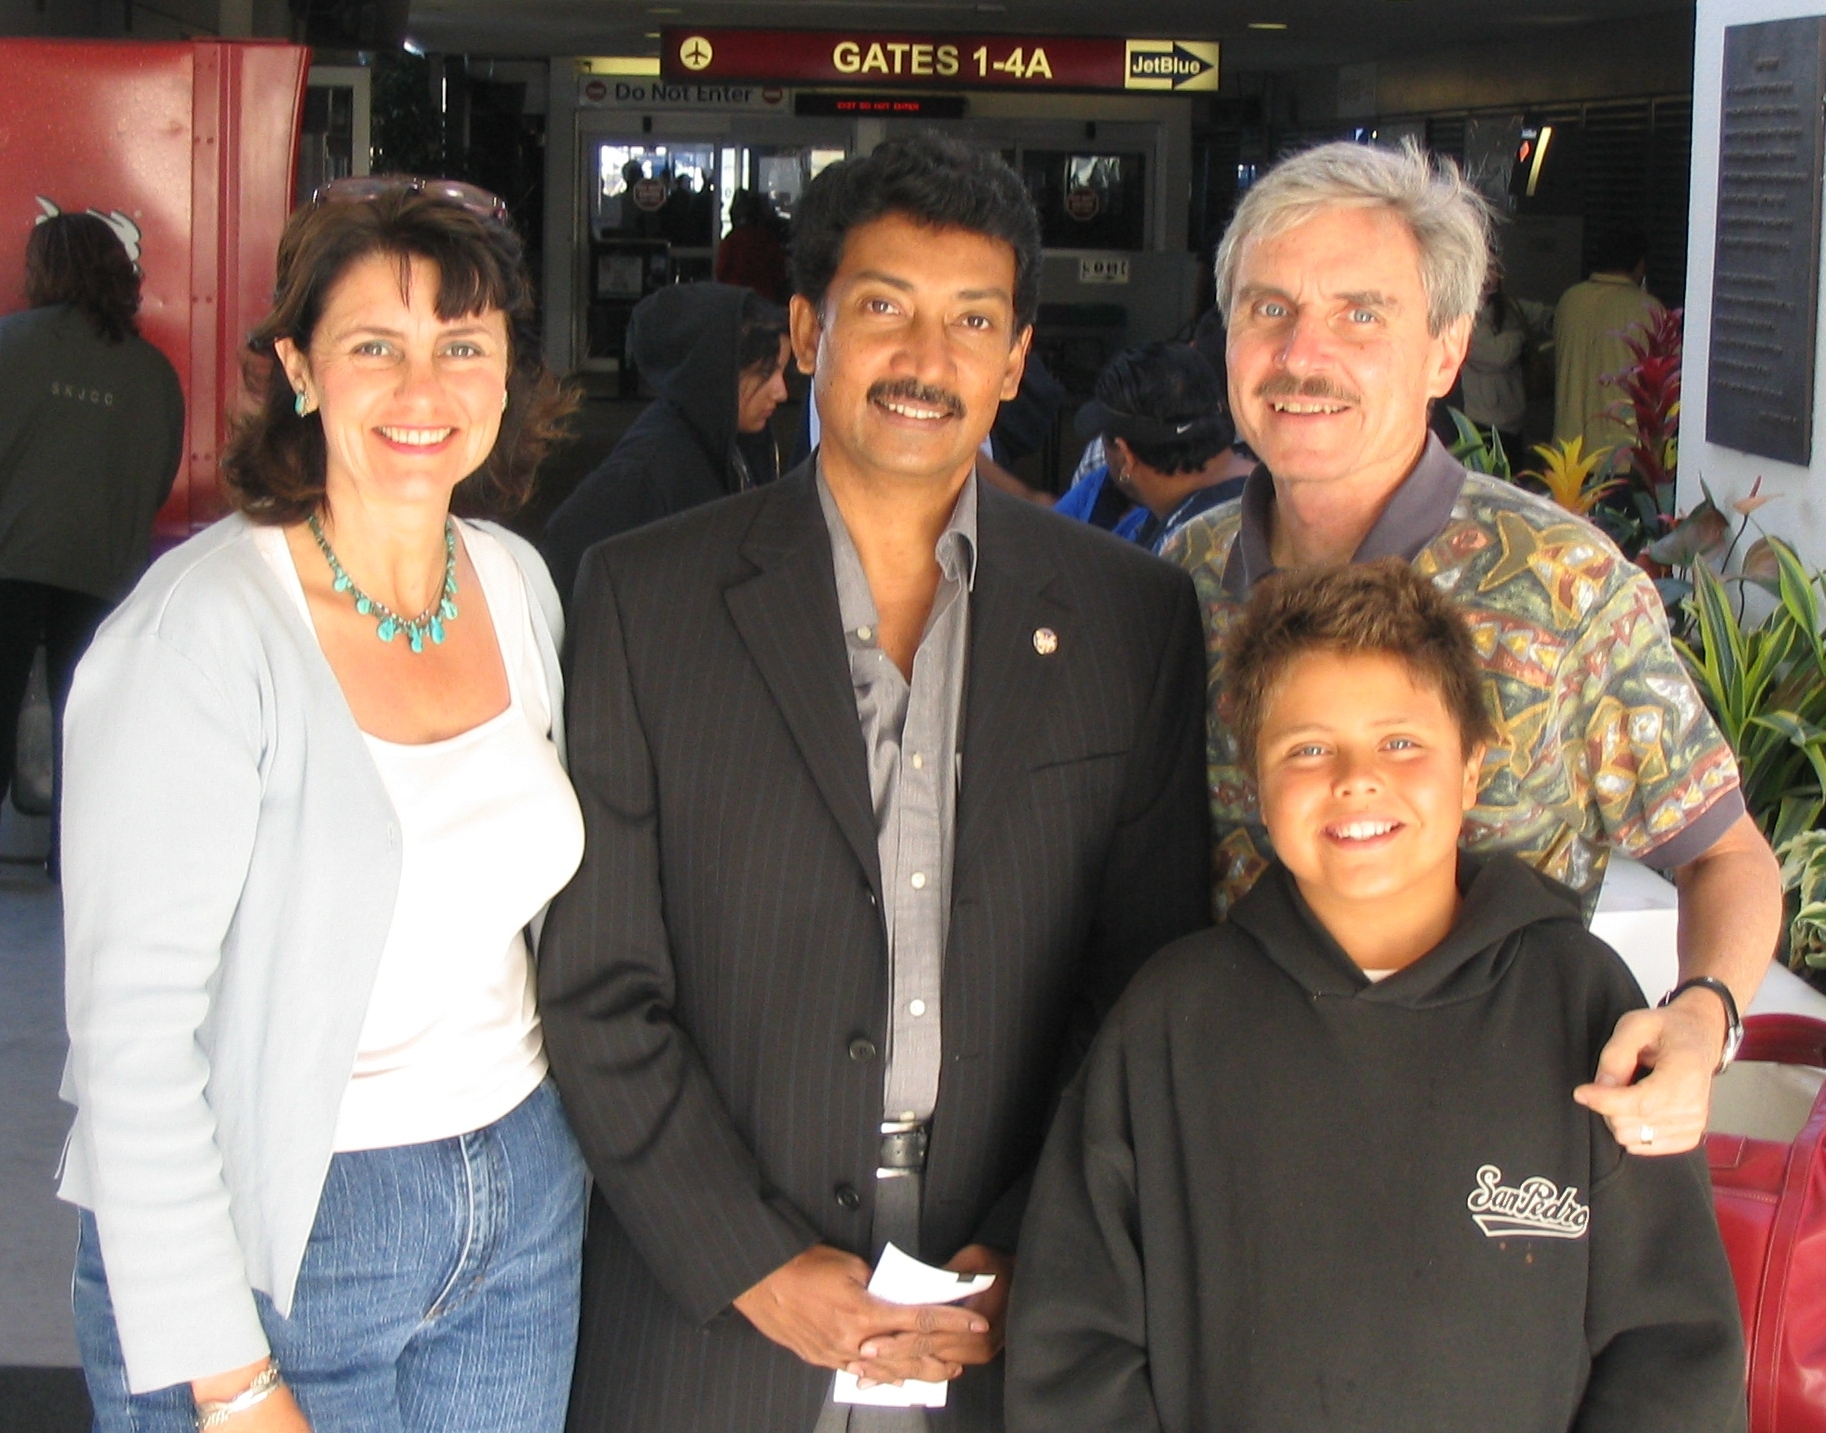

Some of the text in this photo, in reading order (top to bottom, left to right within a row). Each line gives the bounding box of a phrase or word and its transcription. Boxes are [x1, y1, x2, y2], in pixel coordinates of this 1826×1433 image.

[833, 41, 1053, 79] GATES 1-4A
[1132, 54, 1201, 75] JetBlue
[615, 82, 752, 102] Do Not Enter
[1467, 1164, 1590, 1229] San Pedro
